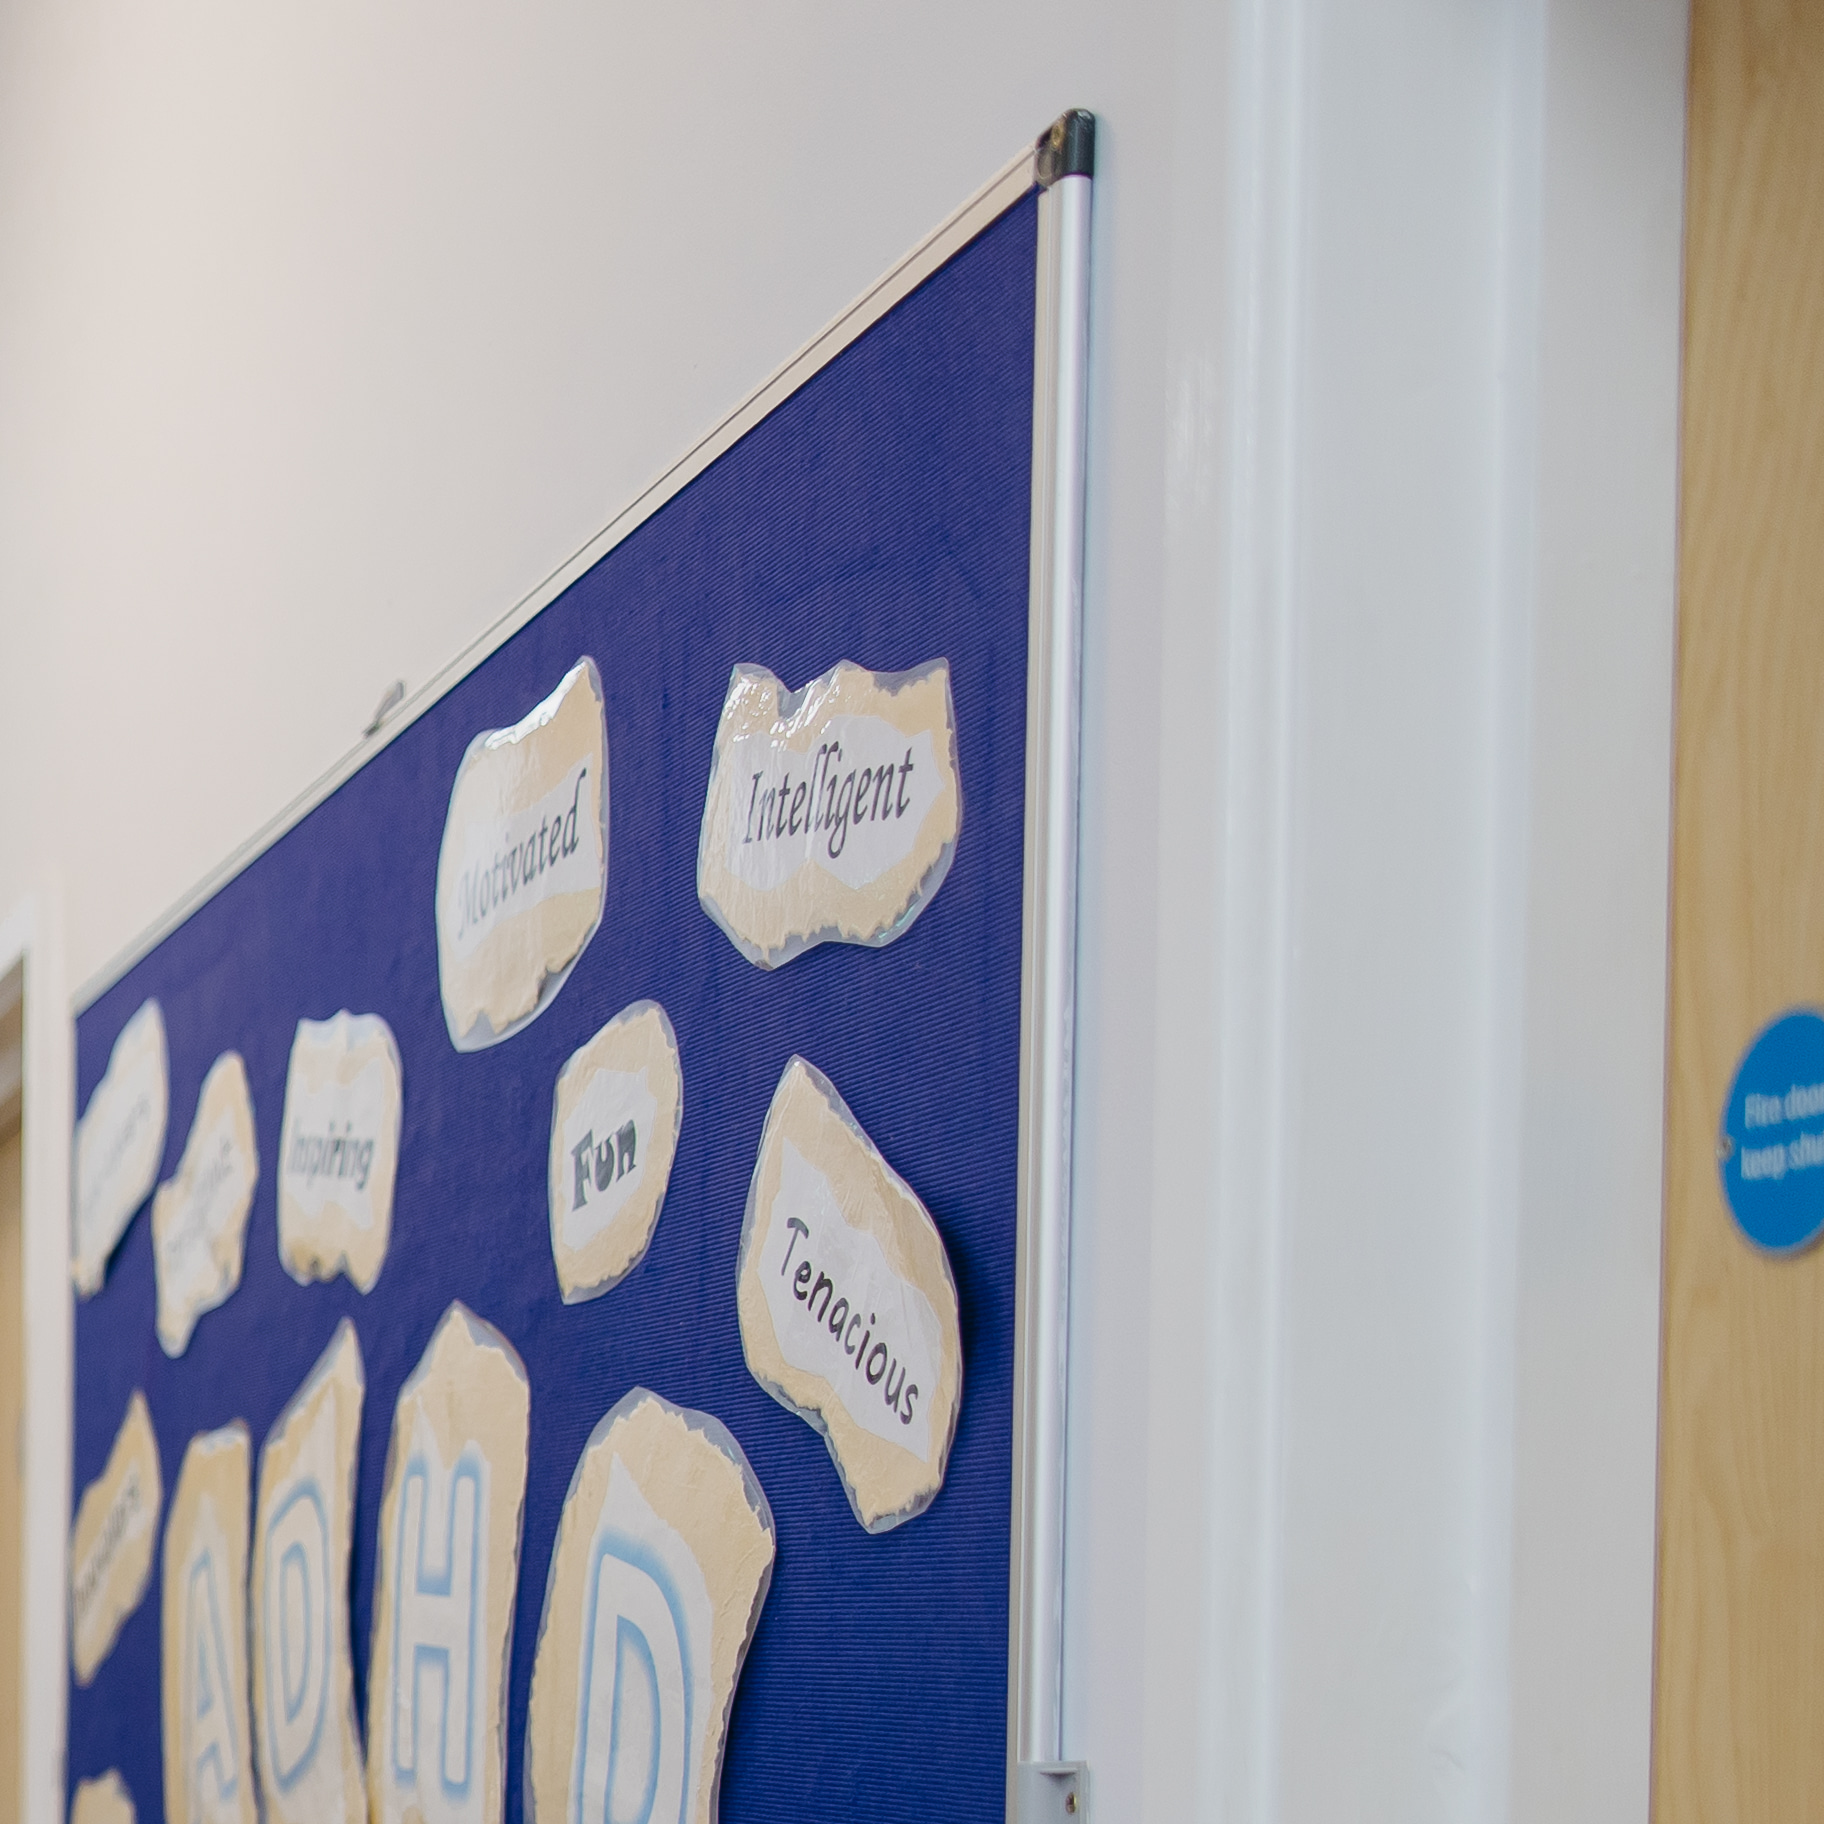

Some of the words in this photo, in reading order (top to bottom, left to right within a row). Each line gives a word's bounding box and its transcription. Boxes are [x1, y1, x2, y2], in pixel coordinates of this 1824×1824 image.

[459, 767, 587, 942] Motivated
[743, 741, 914, 859] Intelligent
[571, 1118, 636, 1212] Fun
[1741, 1145, 1786, 1180] keep
[1788, 1131, 1824, 1170] shu
[781, 1217, 919, 1425] Tenacious
